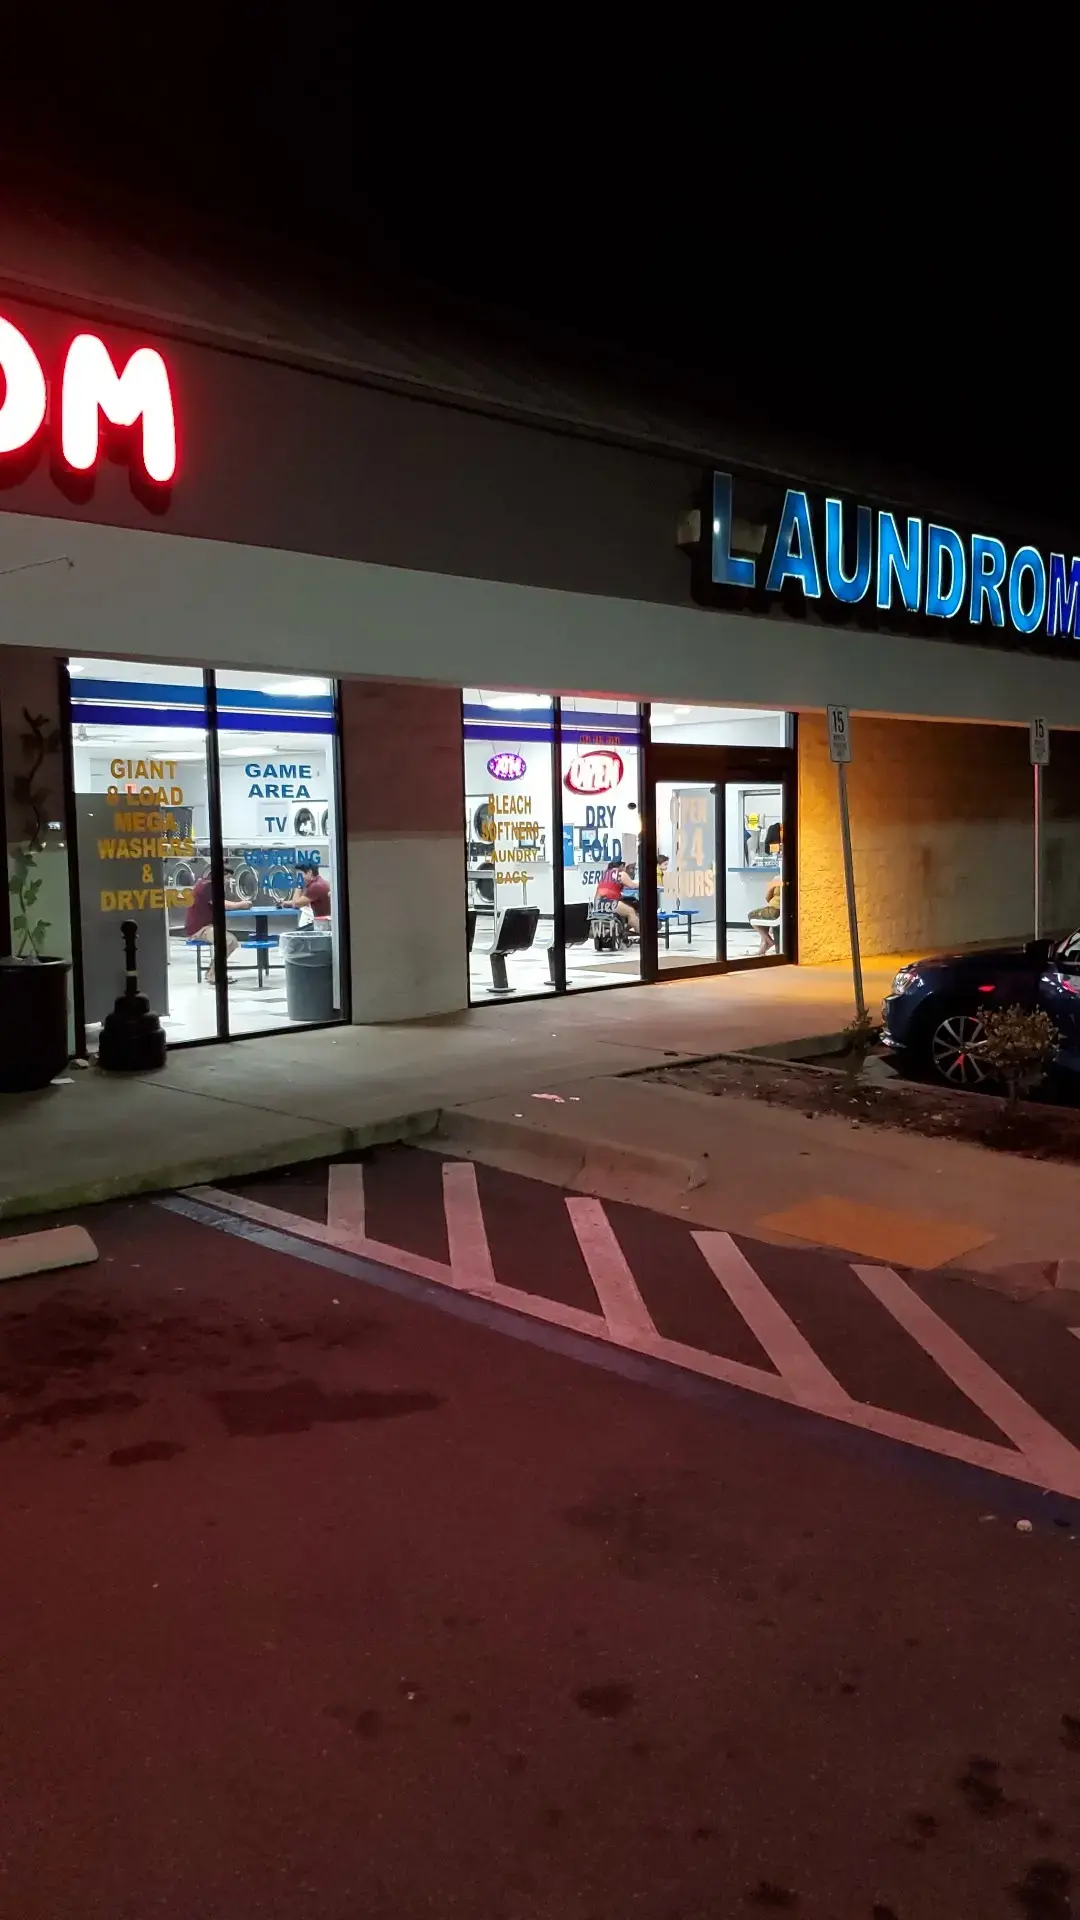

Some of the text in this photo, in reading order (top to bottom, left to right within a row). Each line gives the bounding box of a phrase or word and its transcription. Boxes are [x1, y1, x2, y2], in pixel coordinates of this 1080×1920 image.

[712, 471, 1080, 640] LAUNDROM
[833, 711, 845, 733] 15
[1035, 718, 1045, 738] 15
[110, 758, 178, 780] GIANT
[245, 763, 312, 779] GAME
[570, 757, 620, 790] OPEN
[126, 785, 184, 806] LOAD
[248, 784, 311, 798] AREA
[488, 794, 532, 815] BLEACH
[114, 812, 177, 832] MEGA
[265, 817, 287, 833] TV
[586, 805, 617, 829] DRY
[481, 820, 540, 841] SOFTNERS
[98, 837, 195, 860] WASHERS
[485, 850, 538, 863] LAUNDRY
[582, 839, 622, 862] FOLD
[142, 864, 154, 884] &
[496, 871, 528, 885] BAGS
[582, 868, 622, 885] SERVICE
[100, 888, 194, 911] DRYERS
